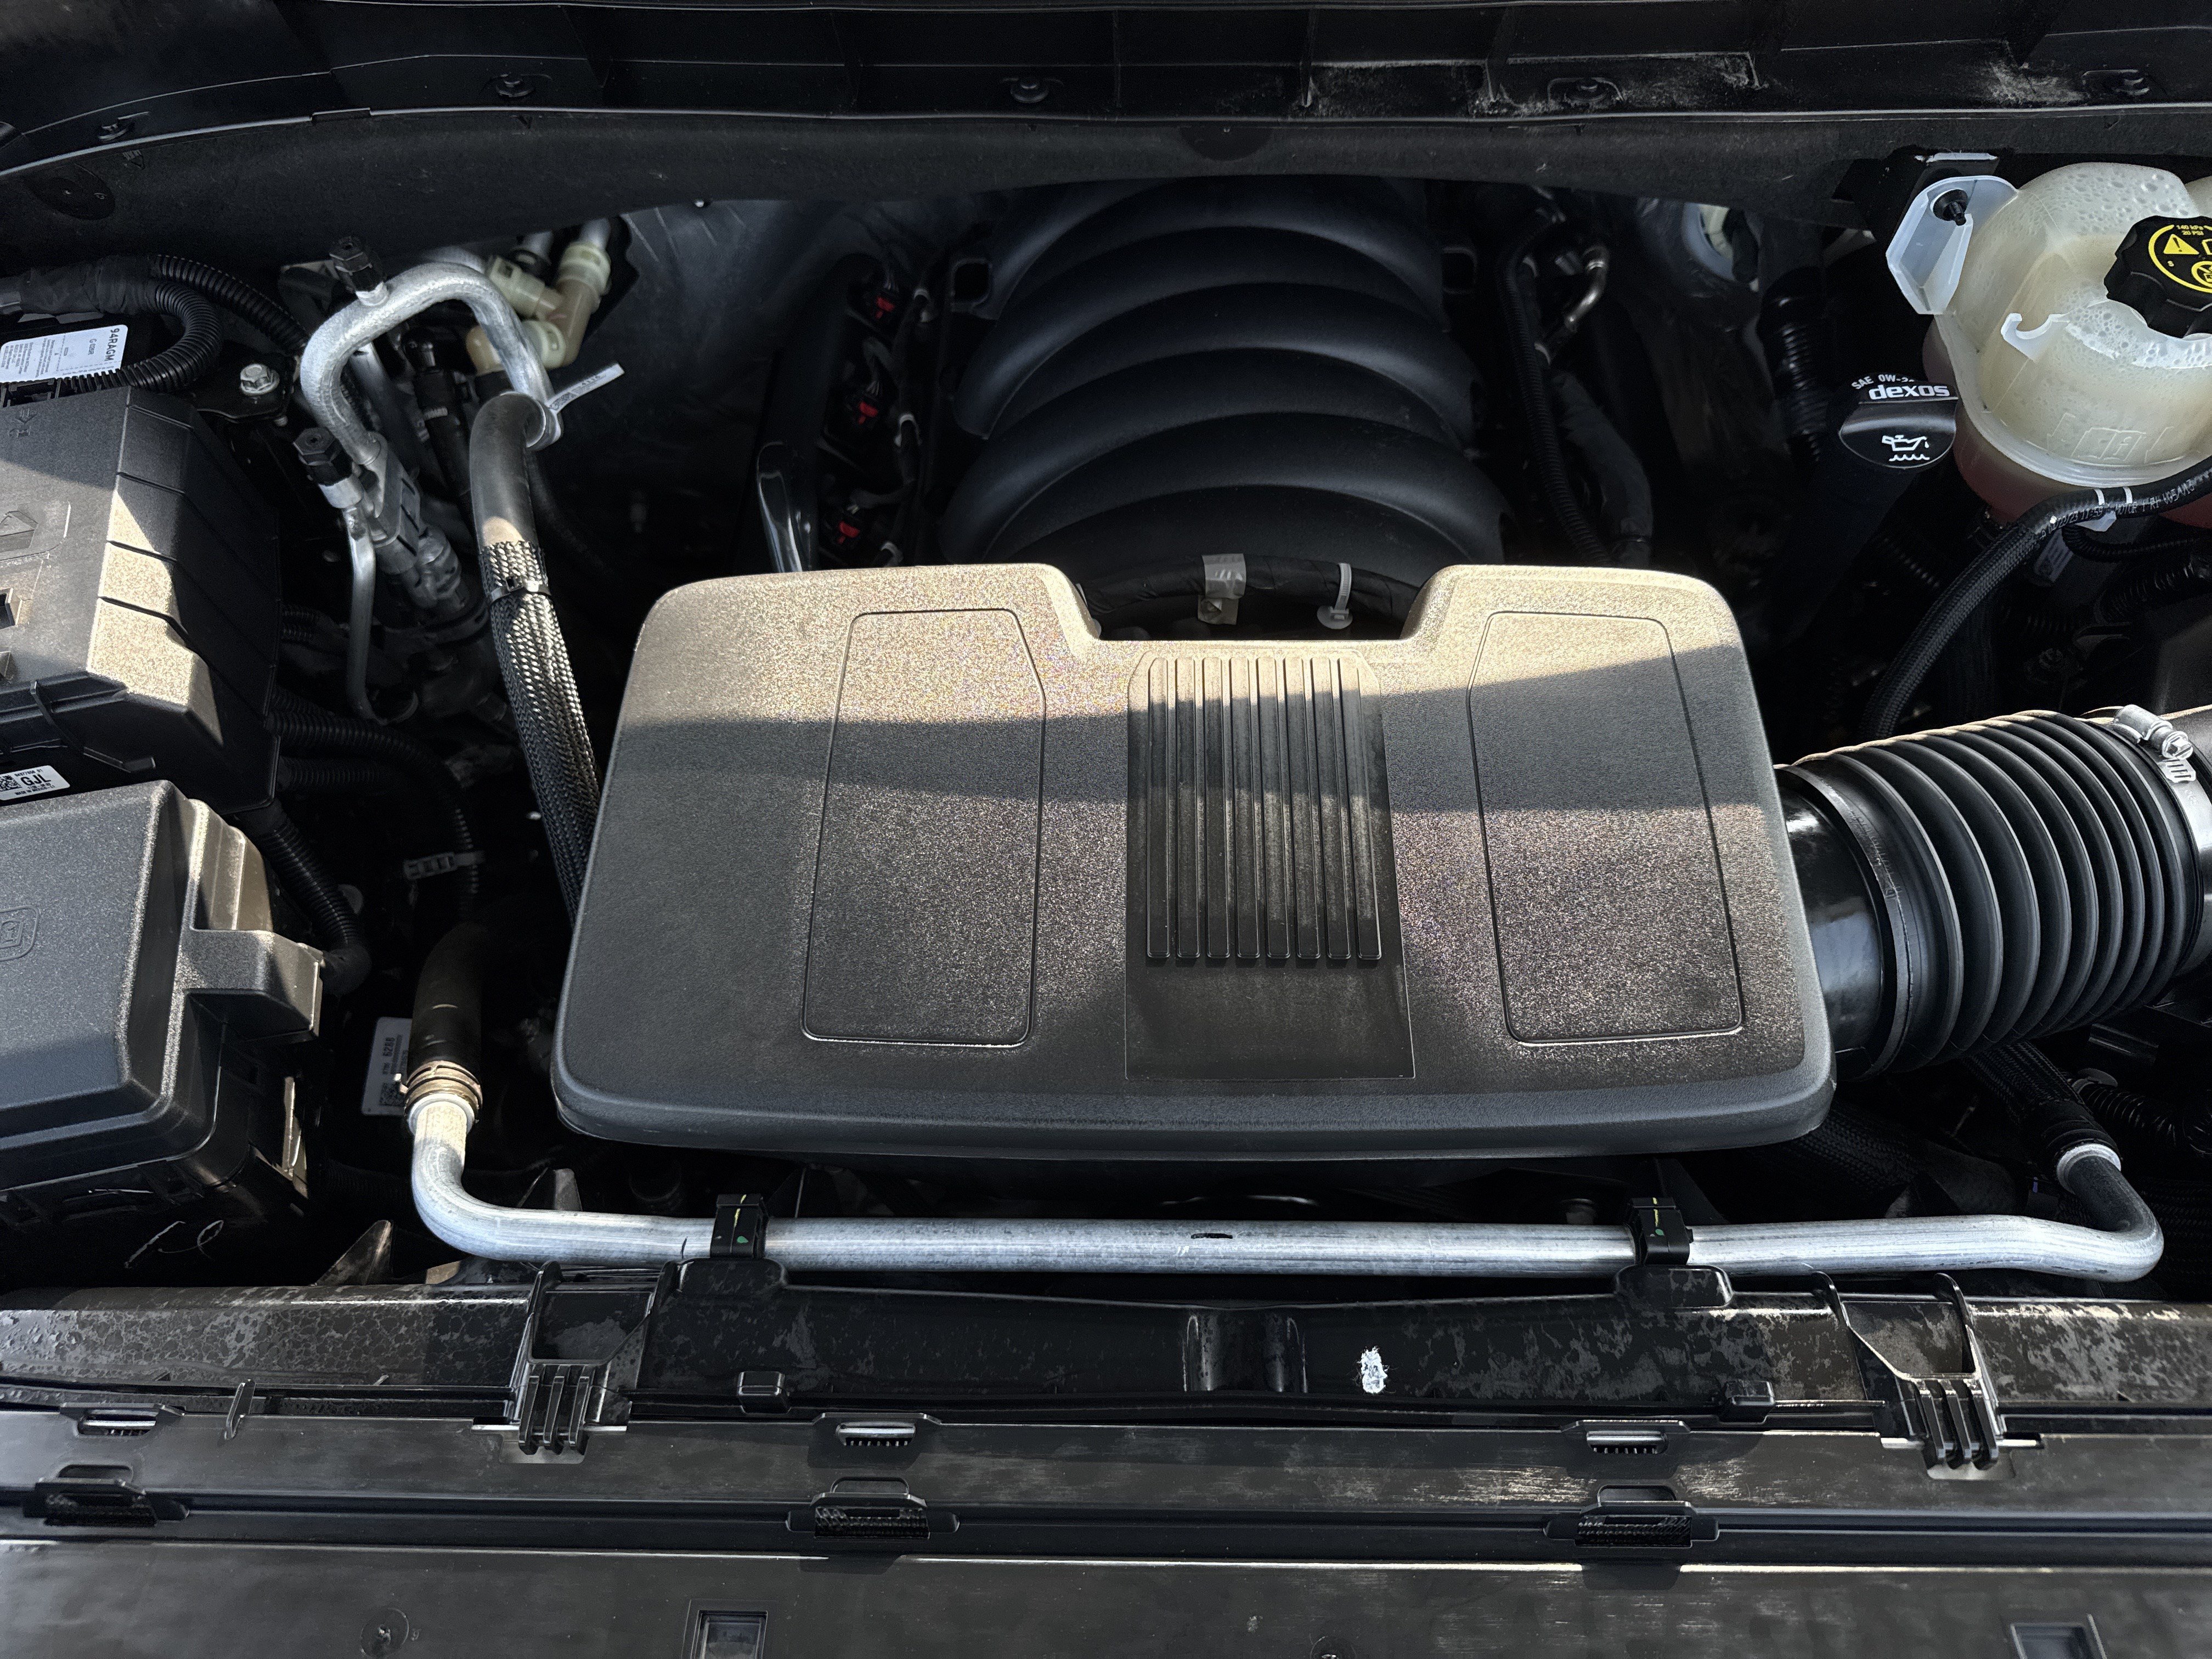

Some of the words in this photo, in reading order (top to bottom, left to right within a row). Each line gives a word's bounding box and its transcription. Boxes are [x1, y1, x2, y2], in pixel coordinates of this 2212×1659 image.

[104, 328, 120, 362] 94RAGM
[1851, 376, 1874, 390] SAE
[1877, 374, 1915, 383] 0W-2
[1869, 384, 1950, 400] dexos
[21, 774, 51, 786] GJL
